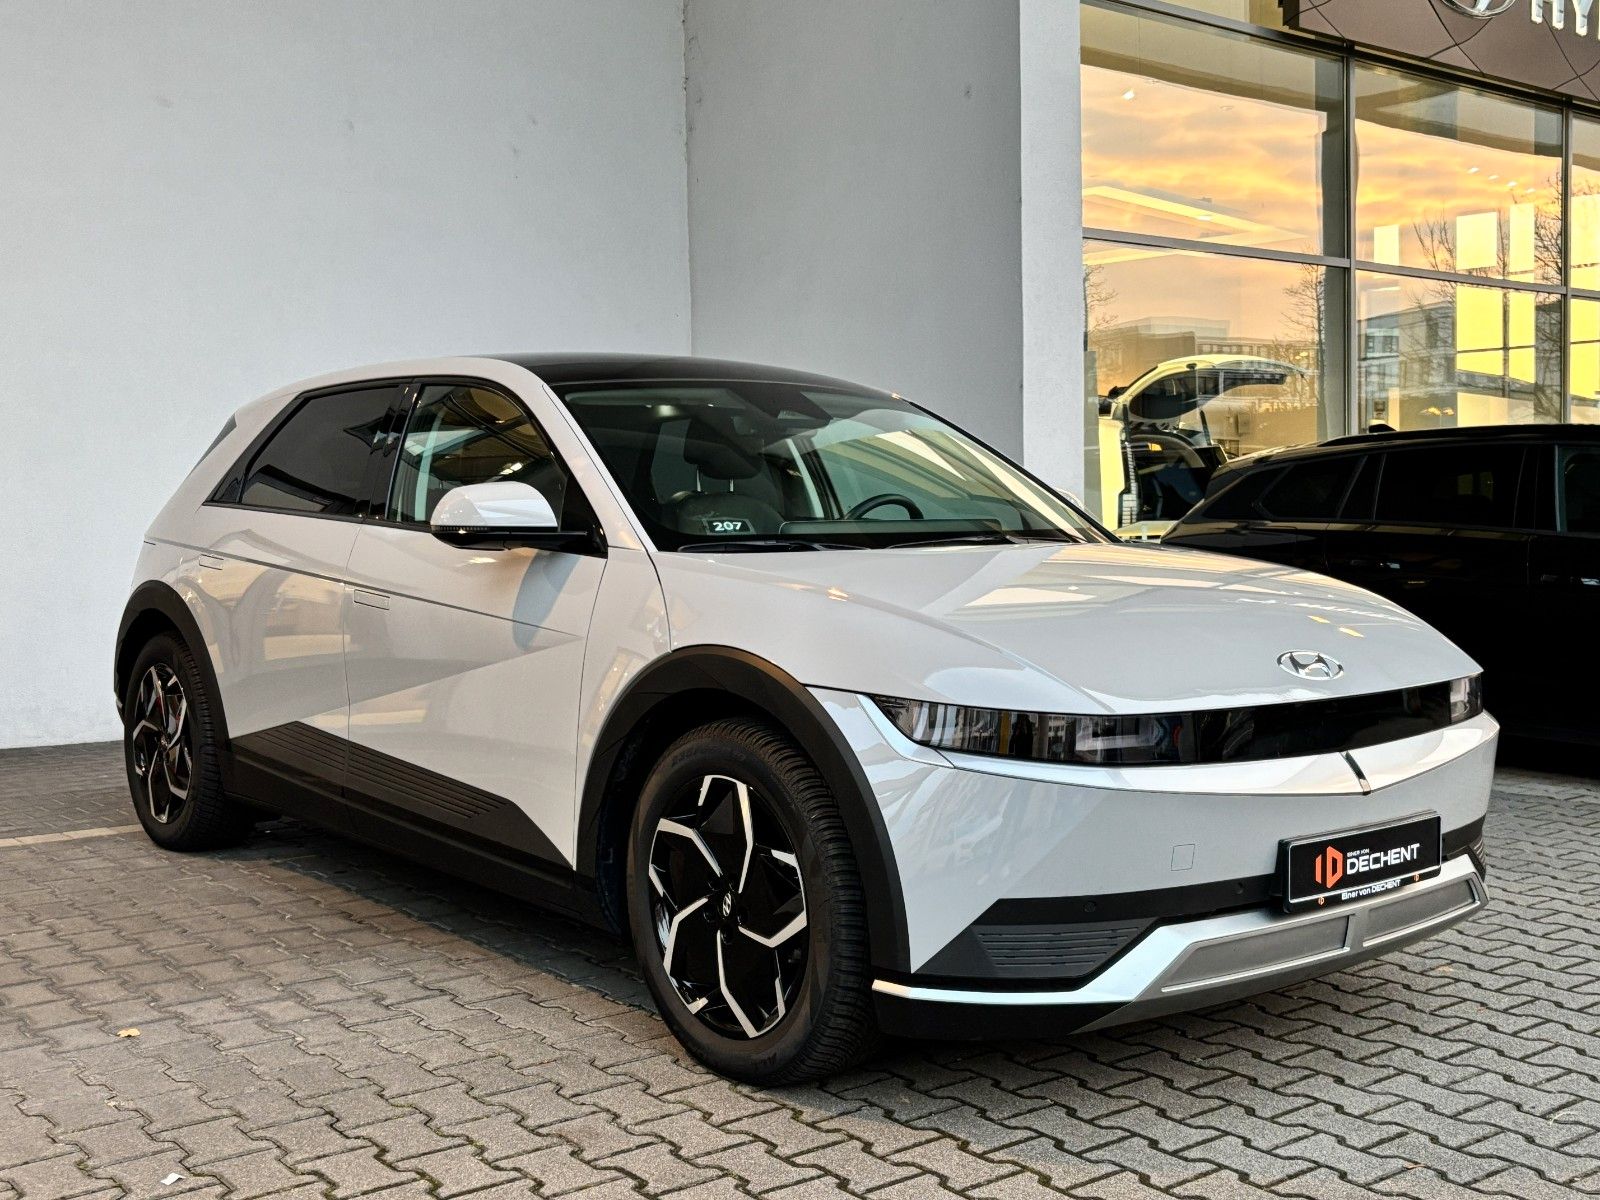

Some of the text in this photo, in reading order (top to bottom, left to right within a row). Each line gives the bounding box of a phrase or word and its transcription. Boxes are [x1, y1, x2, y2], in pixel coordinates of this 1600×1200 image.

[1531, 0, 1600, 40] HY
[712, 521, 742, 531] 207
[1346, 843, 1420, 875] DECHENT
[1341, 880, 1401, 900] Einer von DECHENT
